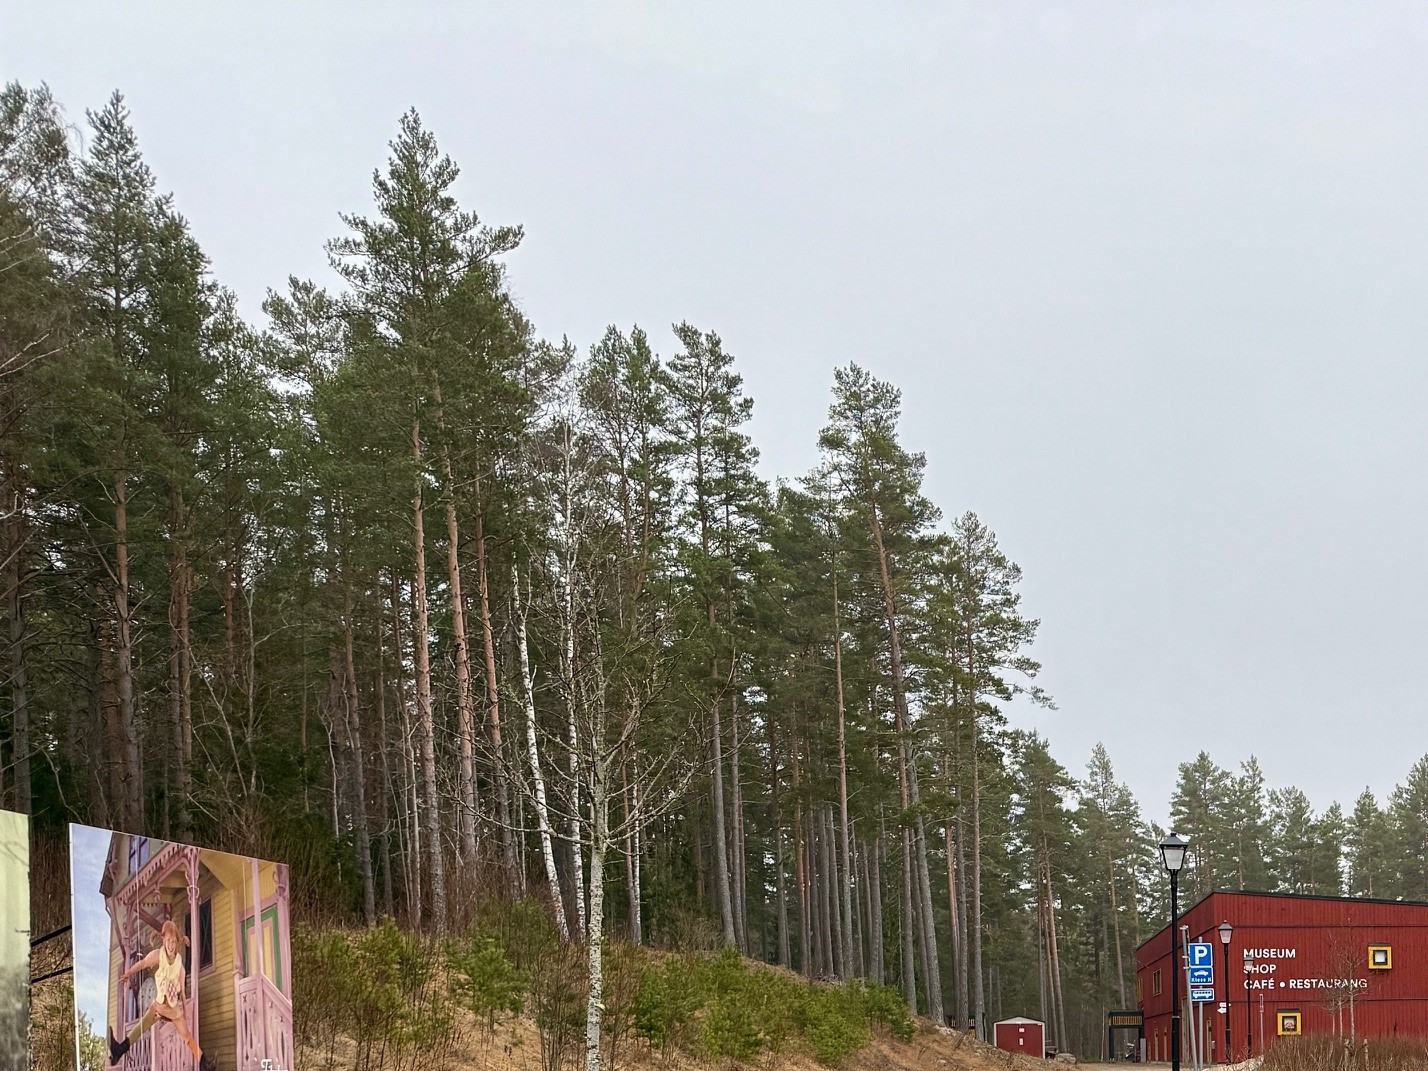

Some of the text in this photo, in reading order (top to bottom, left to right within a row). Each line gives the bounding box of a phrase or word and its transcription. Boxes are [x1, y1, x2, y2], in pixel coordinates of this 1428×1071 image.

[1195, 945, 1208, 965] P
[1243, 948, 1296, 958] MUSEUM
[1243, 977, 1368, 989] CAFÉ RESTAURANG
